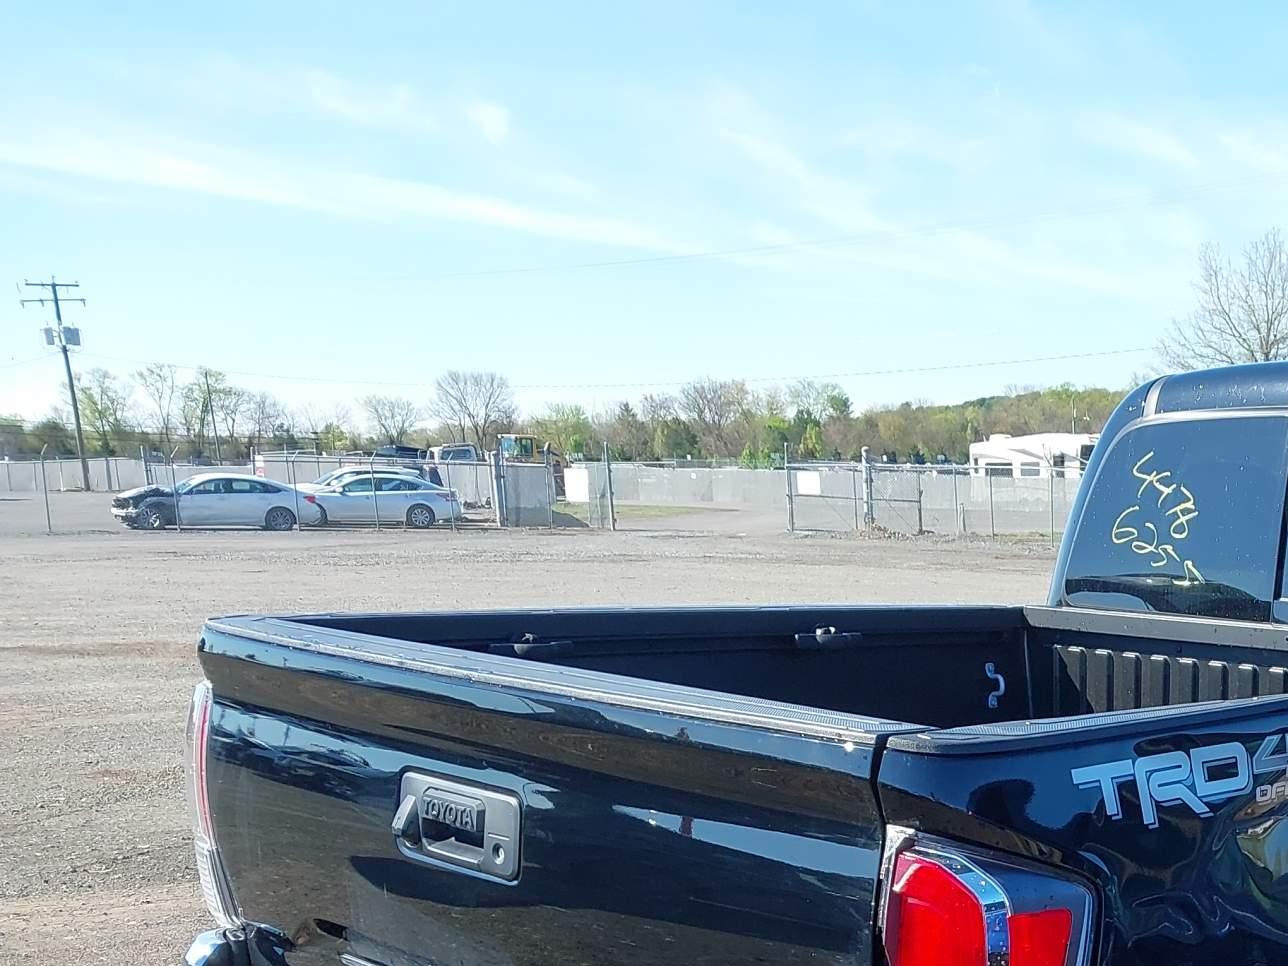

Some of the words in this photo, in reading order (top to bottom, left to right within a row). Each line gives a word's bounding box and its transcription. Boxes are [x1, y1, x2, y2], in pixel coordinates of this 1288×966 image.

[1132, 450, 1199, 539] 4478
[421, 798, 476, 832] TOYOTA
[1070, 740, 1252, 830] TRD
